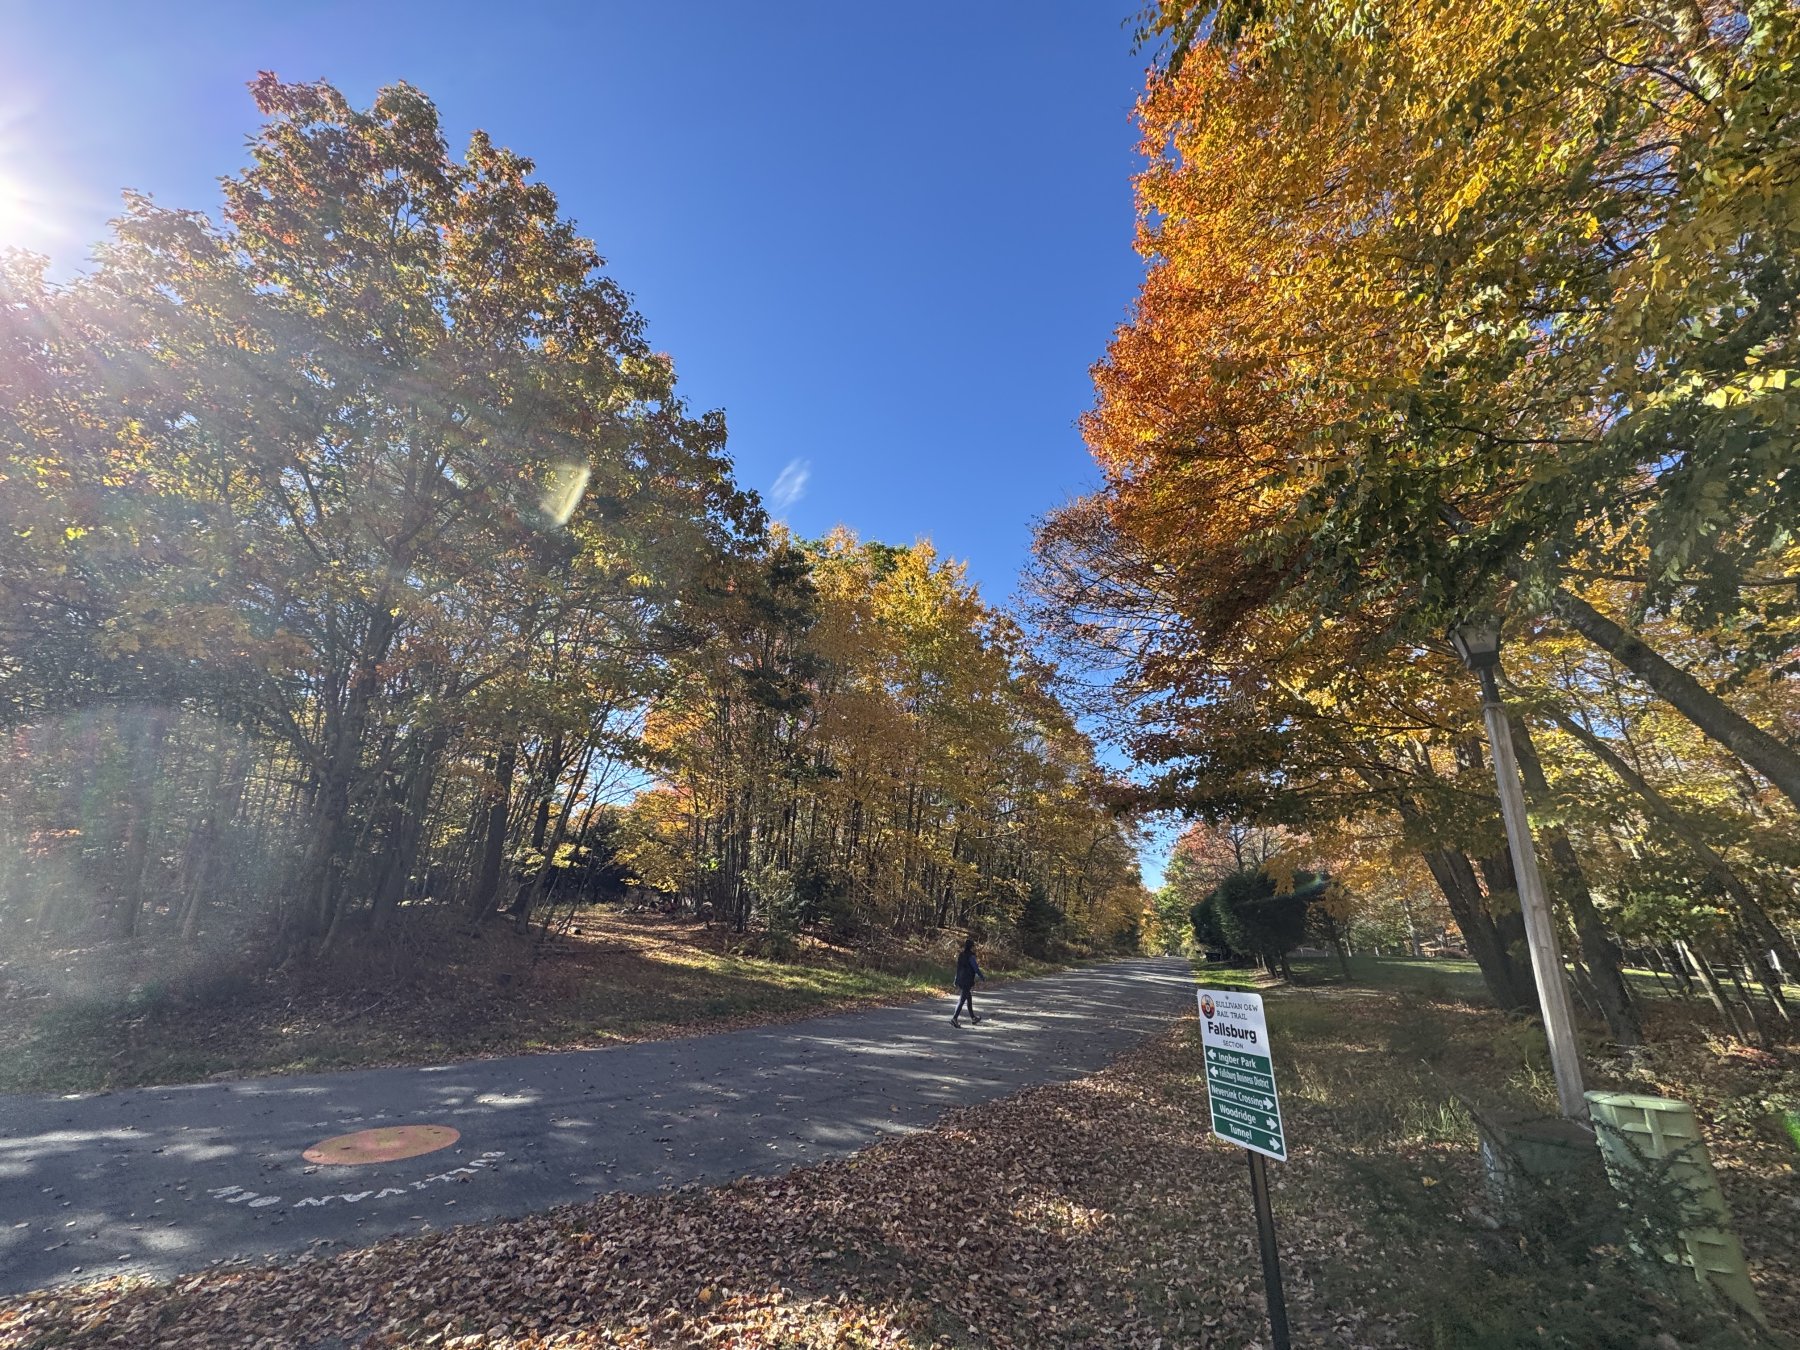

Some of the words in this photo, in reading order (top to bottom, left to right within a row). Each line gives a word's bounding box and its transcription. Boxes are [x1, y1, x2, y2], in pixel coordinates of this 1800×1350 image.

[1215, 1000, 1243, 1010] SULLIVAN
[1230, 1011, 1248, 1020] TRAIL
[1207, 1021, 1257, 1044] Fallsburg
[1222, 1040, 1244, 1049] SECTION
[1218, 1052, 1239, 1065] Ingber
[1240, 1057, 1257, 1069] Park
[1219, 1068, 1237, 1083] Fallsburg
[1236, 1072, 1254, 1085] Business
[1254, 1075, 1270, 1089] District
[1211, 1084, 1238, 1100] Neversink
[1238, 1092, 1264, 1109] Crossing
[1218, 1103, 1257, 1124] Woodridge
[1229, 1123, 1252, 1140] Tunnel
